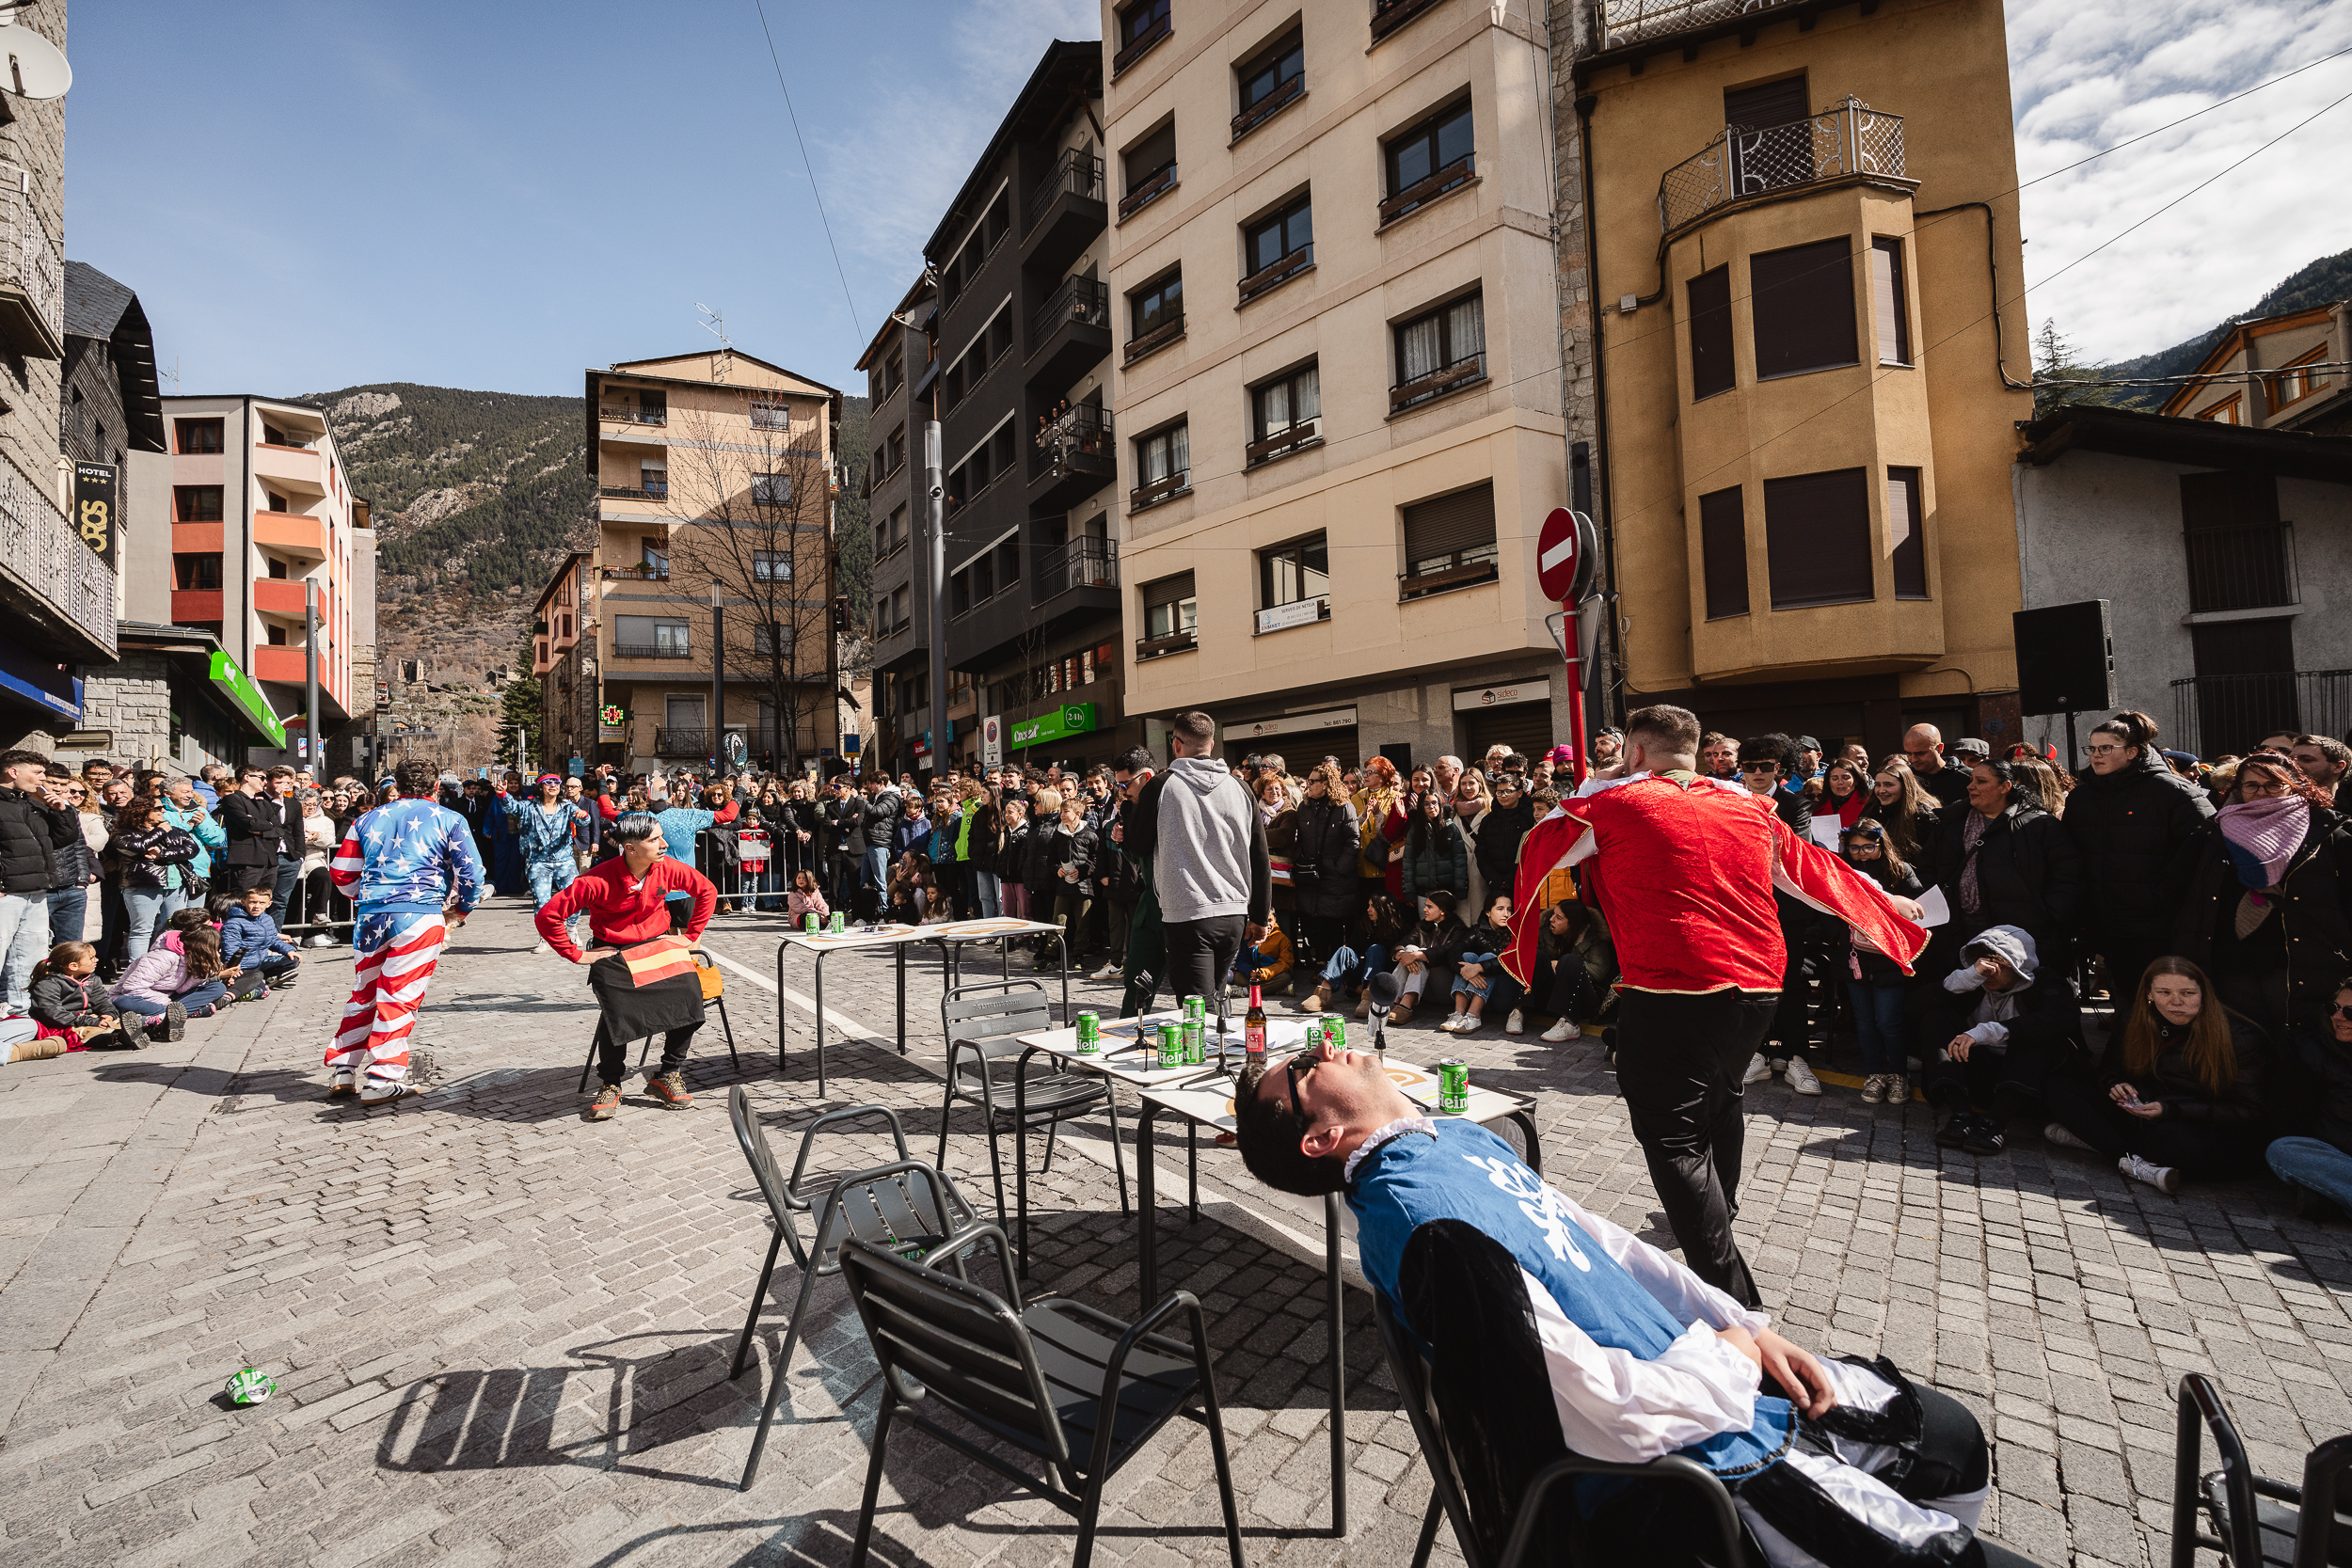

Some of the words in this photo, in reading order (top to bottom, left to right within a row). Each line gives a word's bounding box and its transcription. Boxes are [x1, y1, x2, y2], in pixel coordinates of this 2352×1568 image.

[78, 467, 112, 477] HOTEL
[81, 499, 108, 552] OROS
[1497, 689, 1518, 698] sideco
